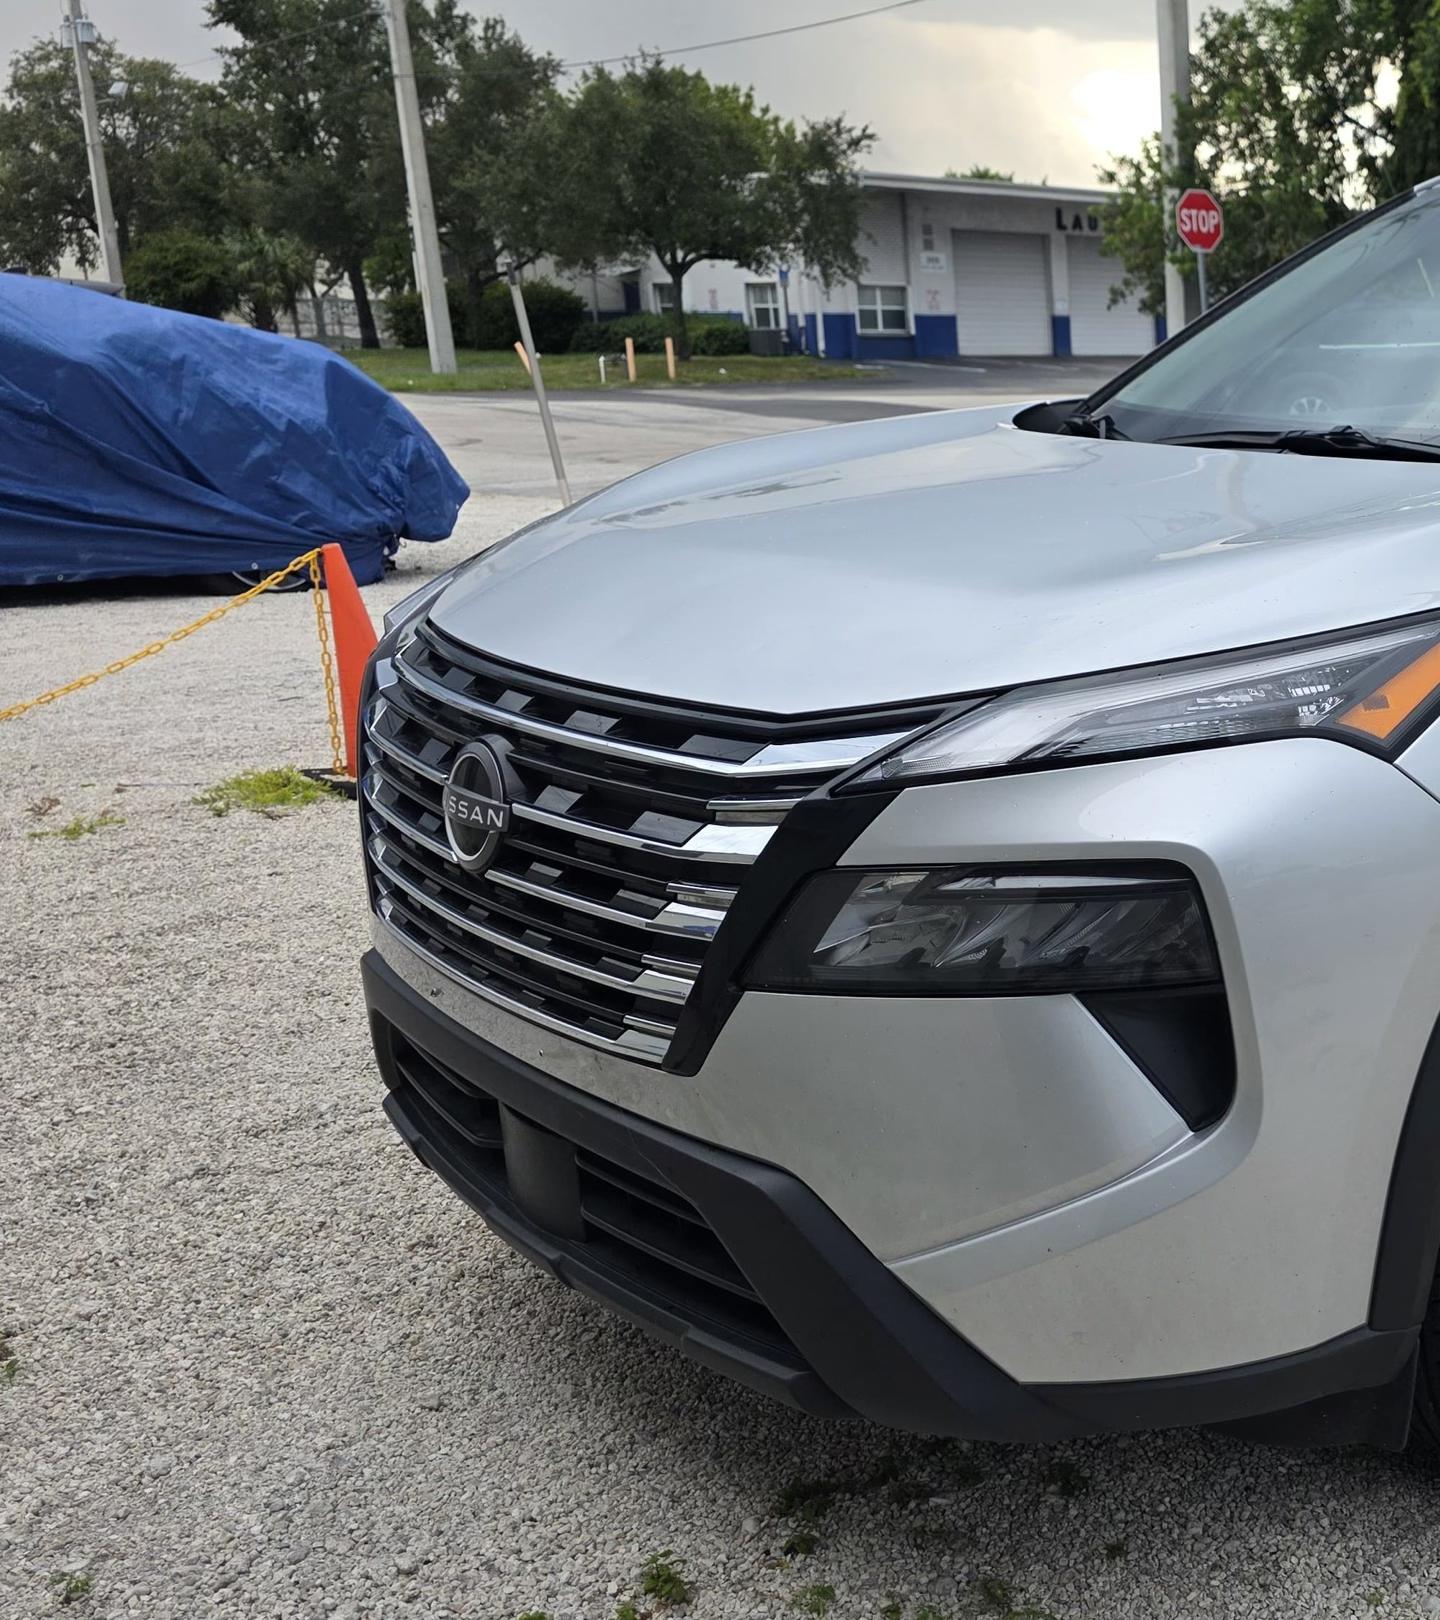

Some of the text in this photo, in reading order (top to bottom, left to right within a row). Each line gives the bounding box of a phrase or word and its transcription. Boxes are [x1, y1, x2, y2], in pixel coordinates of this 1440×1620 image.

[1055, 207, 1098, 231] LAU
[1180, 208, 1219, 234] STOP
[449, 795, 504, 828] SSAN
